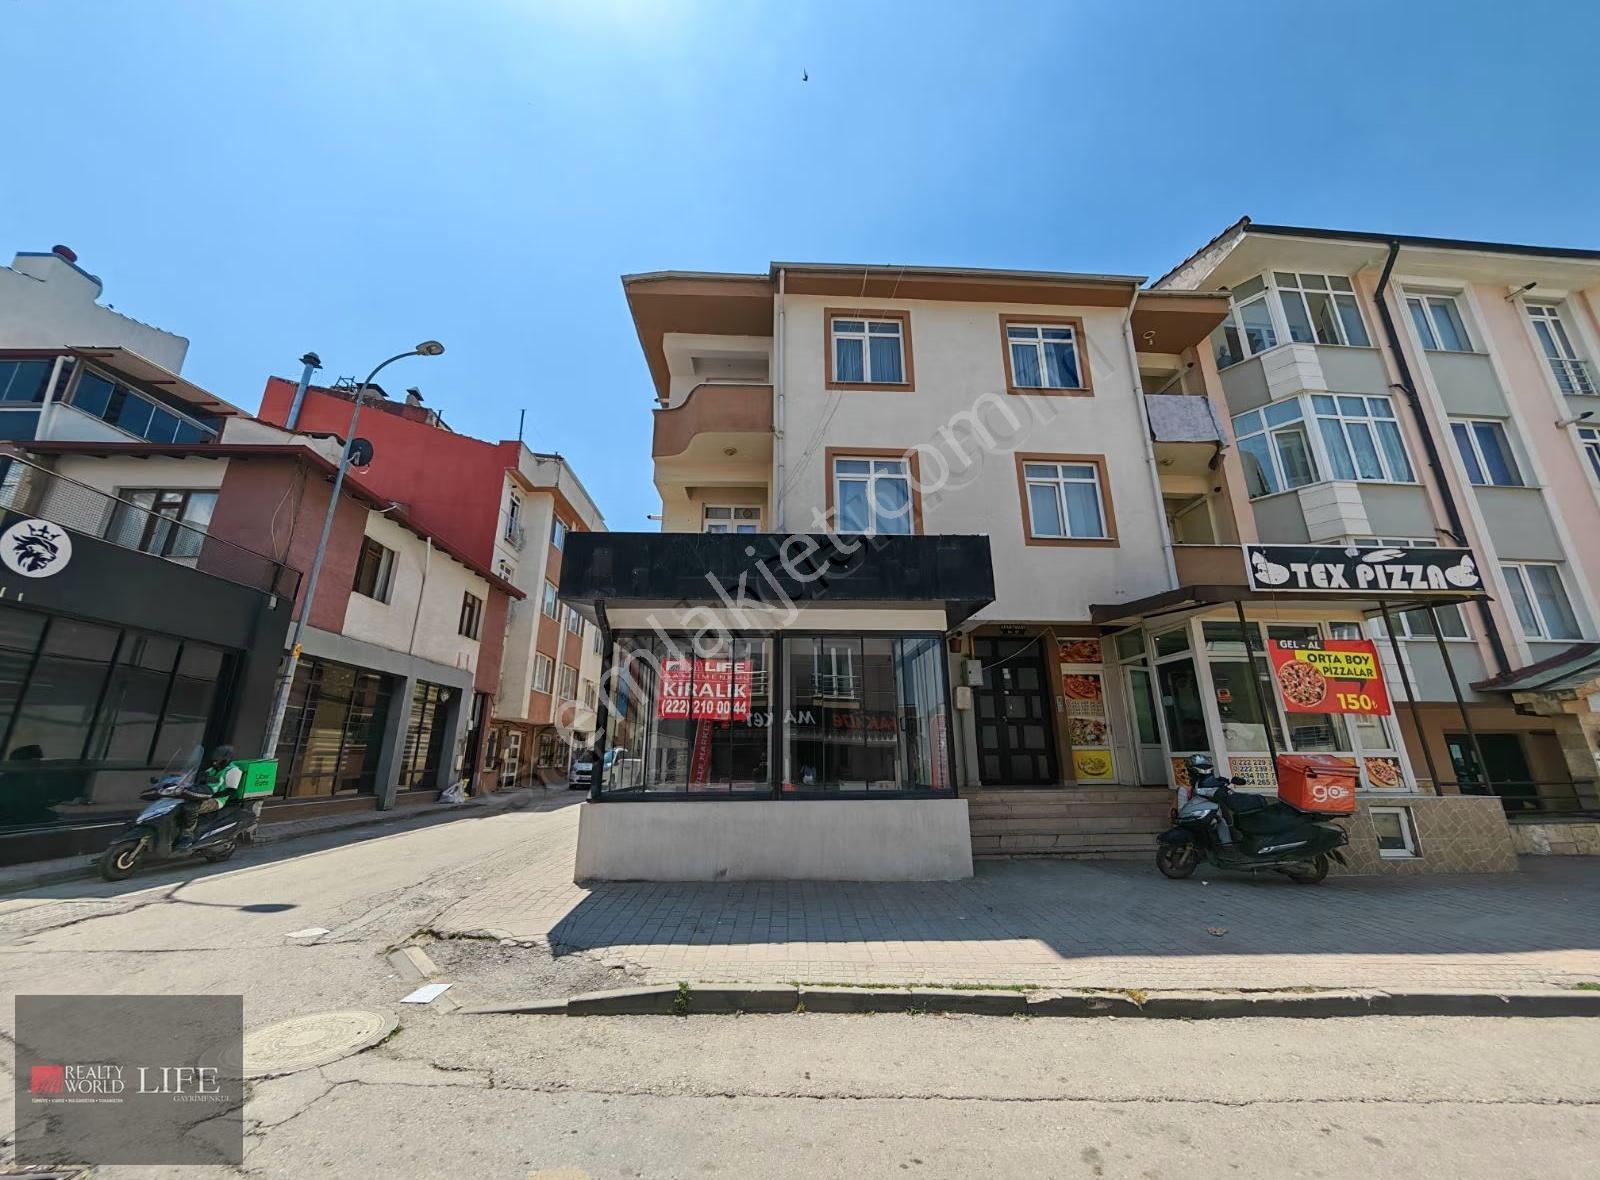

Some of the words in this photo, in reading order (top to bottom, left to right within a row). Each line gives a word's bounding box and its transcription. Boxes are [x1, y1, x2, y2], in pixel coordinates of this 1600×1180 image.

[1290, 563, 1350, 588] TEX
[1356, 563, 1448, 589] PIZZA
[1280, 640, 1299, 649] GEL
[1308, 641, 1321, 649] AL
[1307, 653, 1342, 664] ORTA
[1346, 655, 1369, 665] BOY
[705, 661, 745, 673] LIFE
[661, 699, 690, 717] (222)
[693, 700, 713, 714] 210
[717, 700, 731, 714] 00
[733, 701, 747, 715] 44
